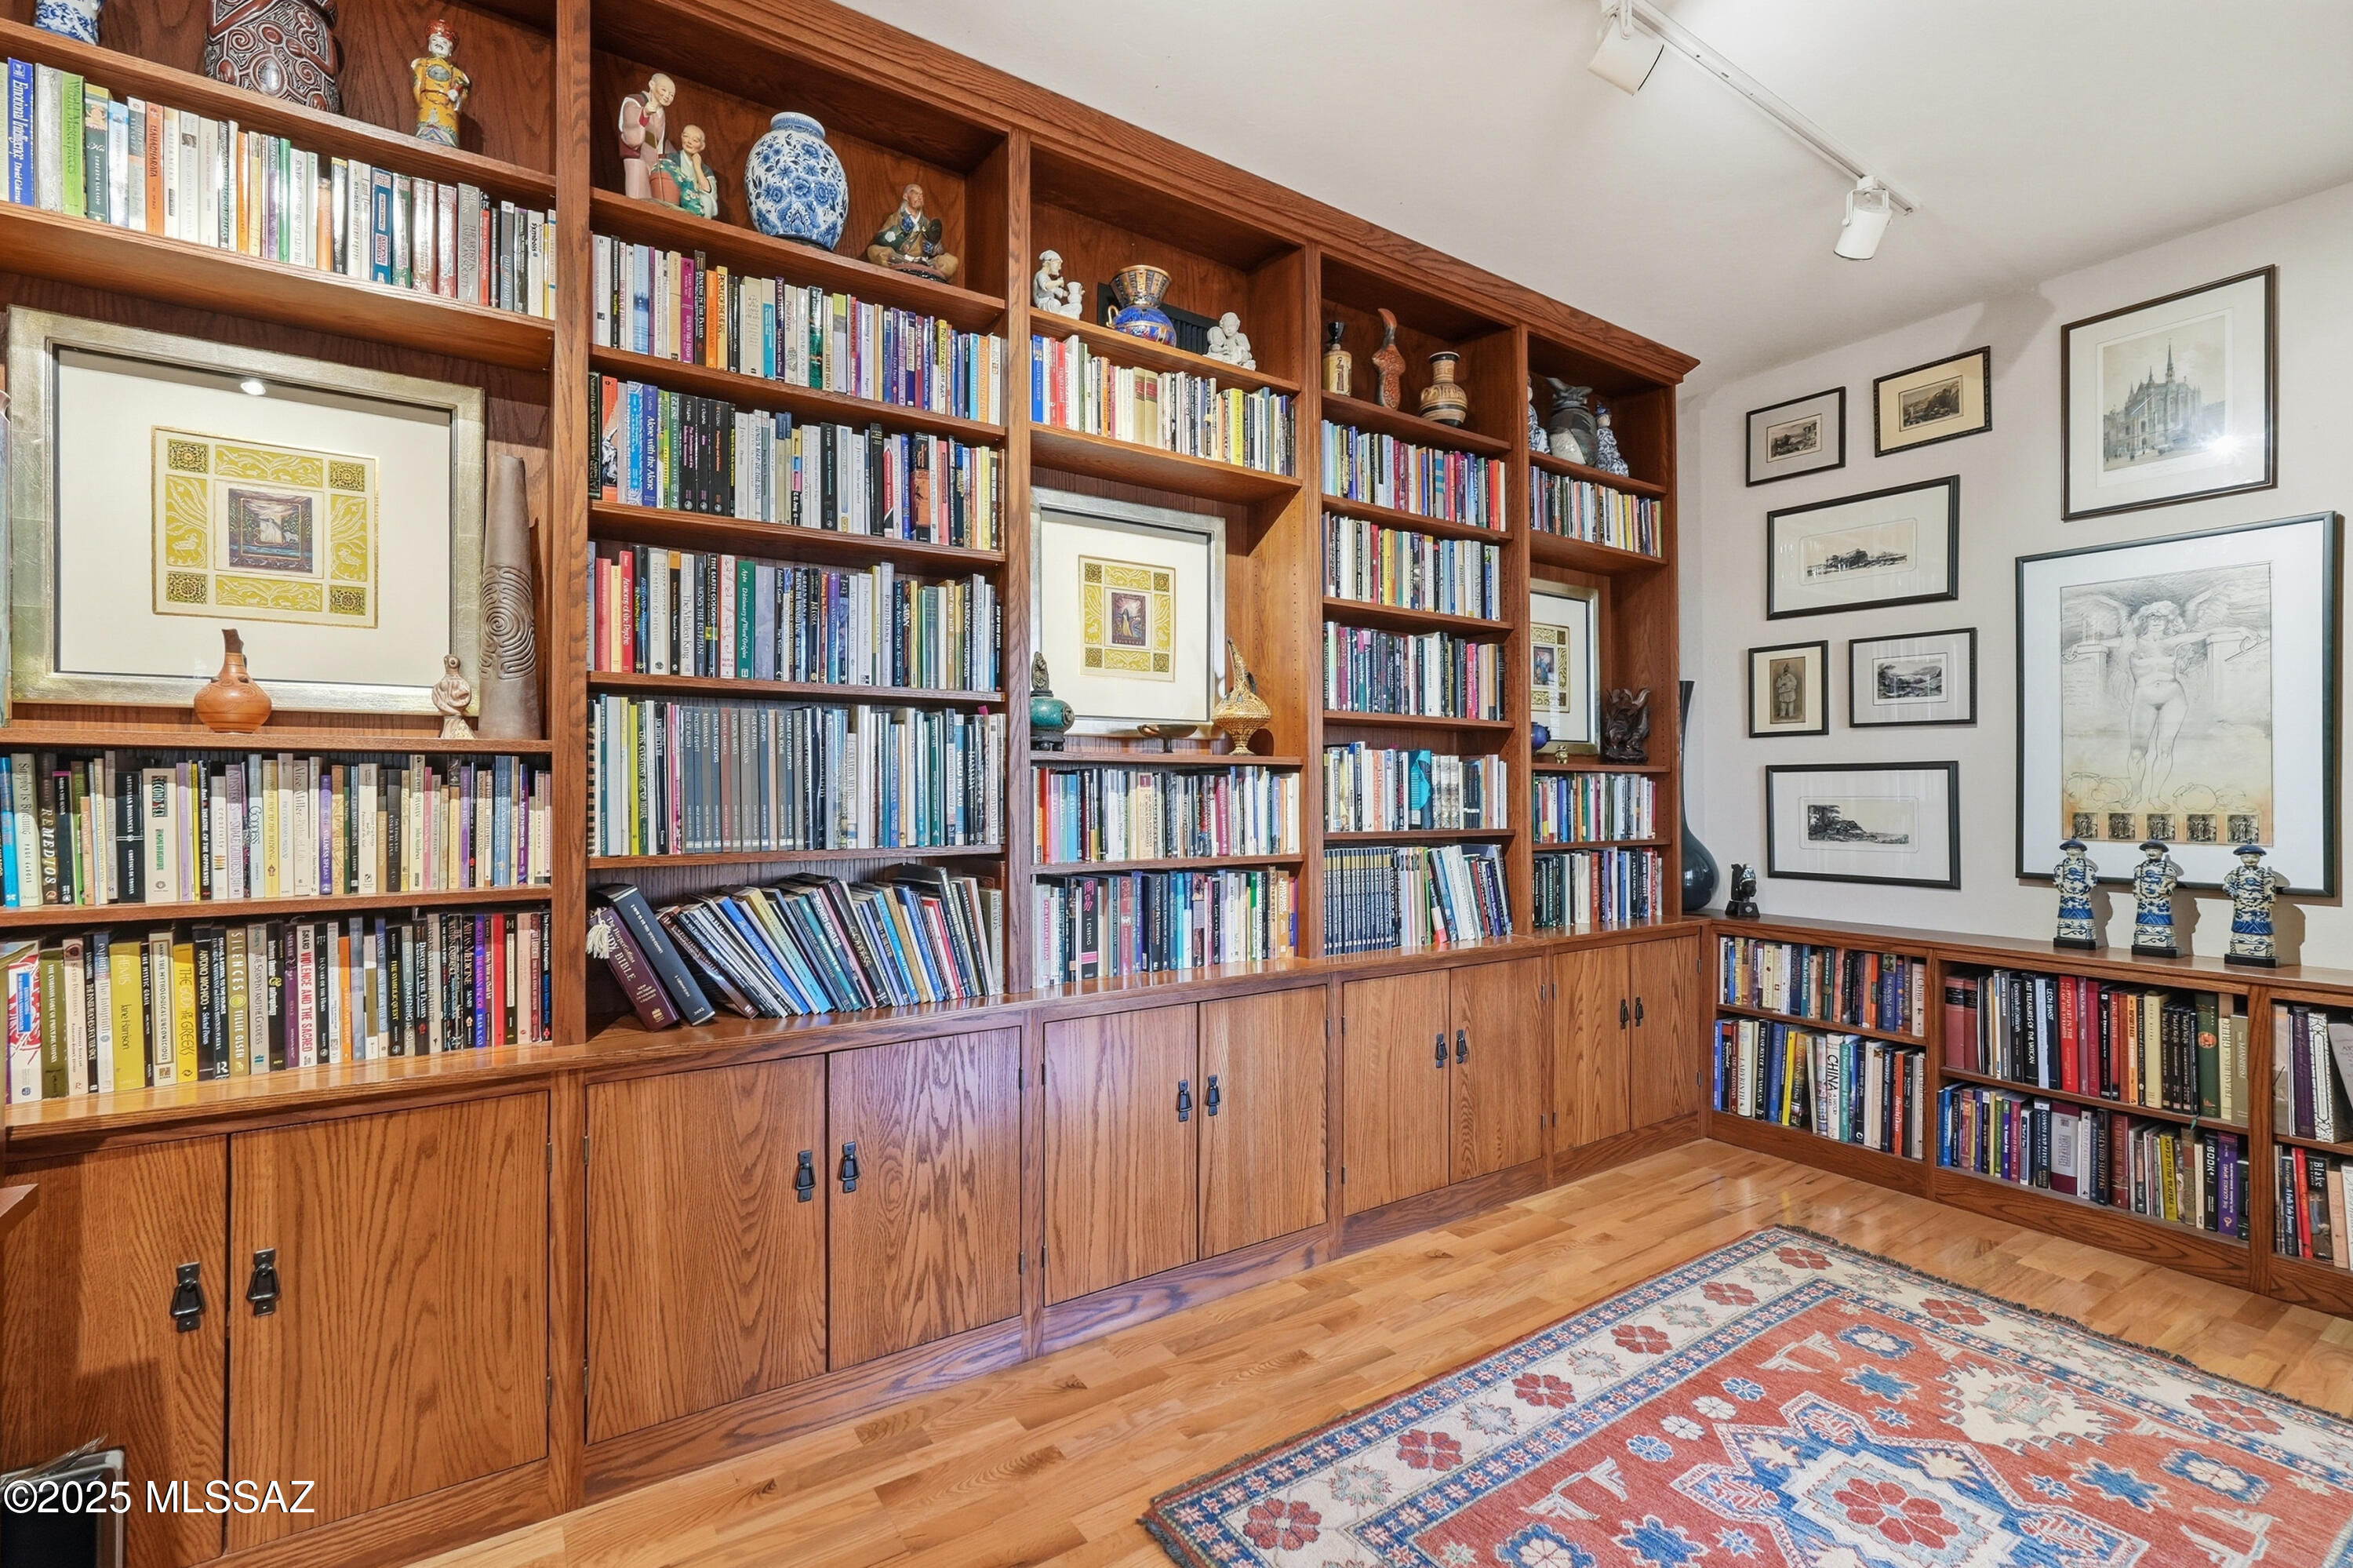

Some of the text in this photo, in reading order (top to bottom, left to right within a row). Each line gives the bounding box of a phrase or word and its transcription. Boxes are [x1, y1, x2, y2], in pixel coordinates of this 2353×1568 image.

[9, 80, 29, 159] Emotional Intelligence
[63, 82, 80, 174] World Masterpieces
[647, 416, 656, 490] Alone with the Alone
[682, 640, 692, 660] King
[16, 763, 32, 791] Sappho
[295, 764, 308, 816] Alice Miller
[151, 776, 166, 817] SECOND SEX
[19, 803, 31, 835] Burning
[216, 808, 224, 849] creativity
[41, 808, 57, 885] REMEDIOS
[606, 915, 636, 964] The HarperCollins
[95, 943, 108, 980] exploring
[180, 967, 193, 986] THE
[197, 950, 209, 976] ANTONIO
[300, 951, 313, 987] VIOLENCE
[615, 951, 637, 982] BIBLE
[100, 982, 109, 995] the
[200, 977, 209, 1005] MACHADO
[231, 932, 245, 1058] SILENCES TILLIE OLSEN
[301, 989, 312, 1005] AND
[120, 1004, 133, 1050] Jane Harrison
[301, 1006, 313, 1021] THE
[179, 1021, 195, 1057] GREEKS
[301, 1023, 313, 1052] SACRED
[1827, 1054, 1839, 1090] CHINA
[2313, 1161, 2326, 1188] Blake
